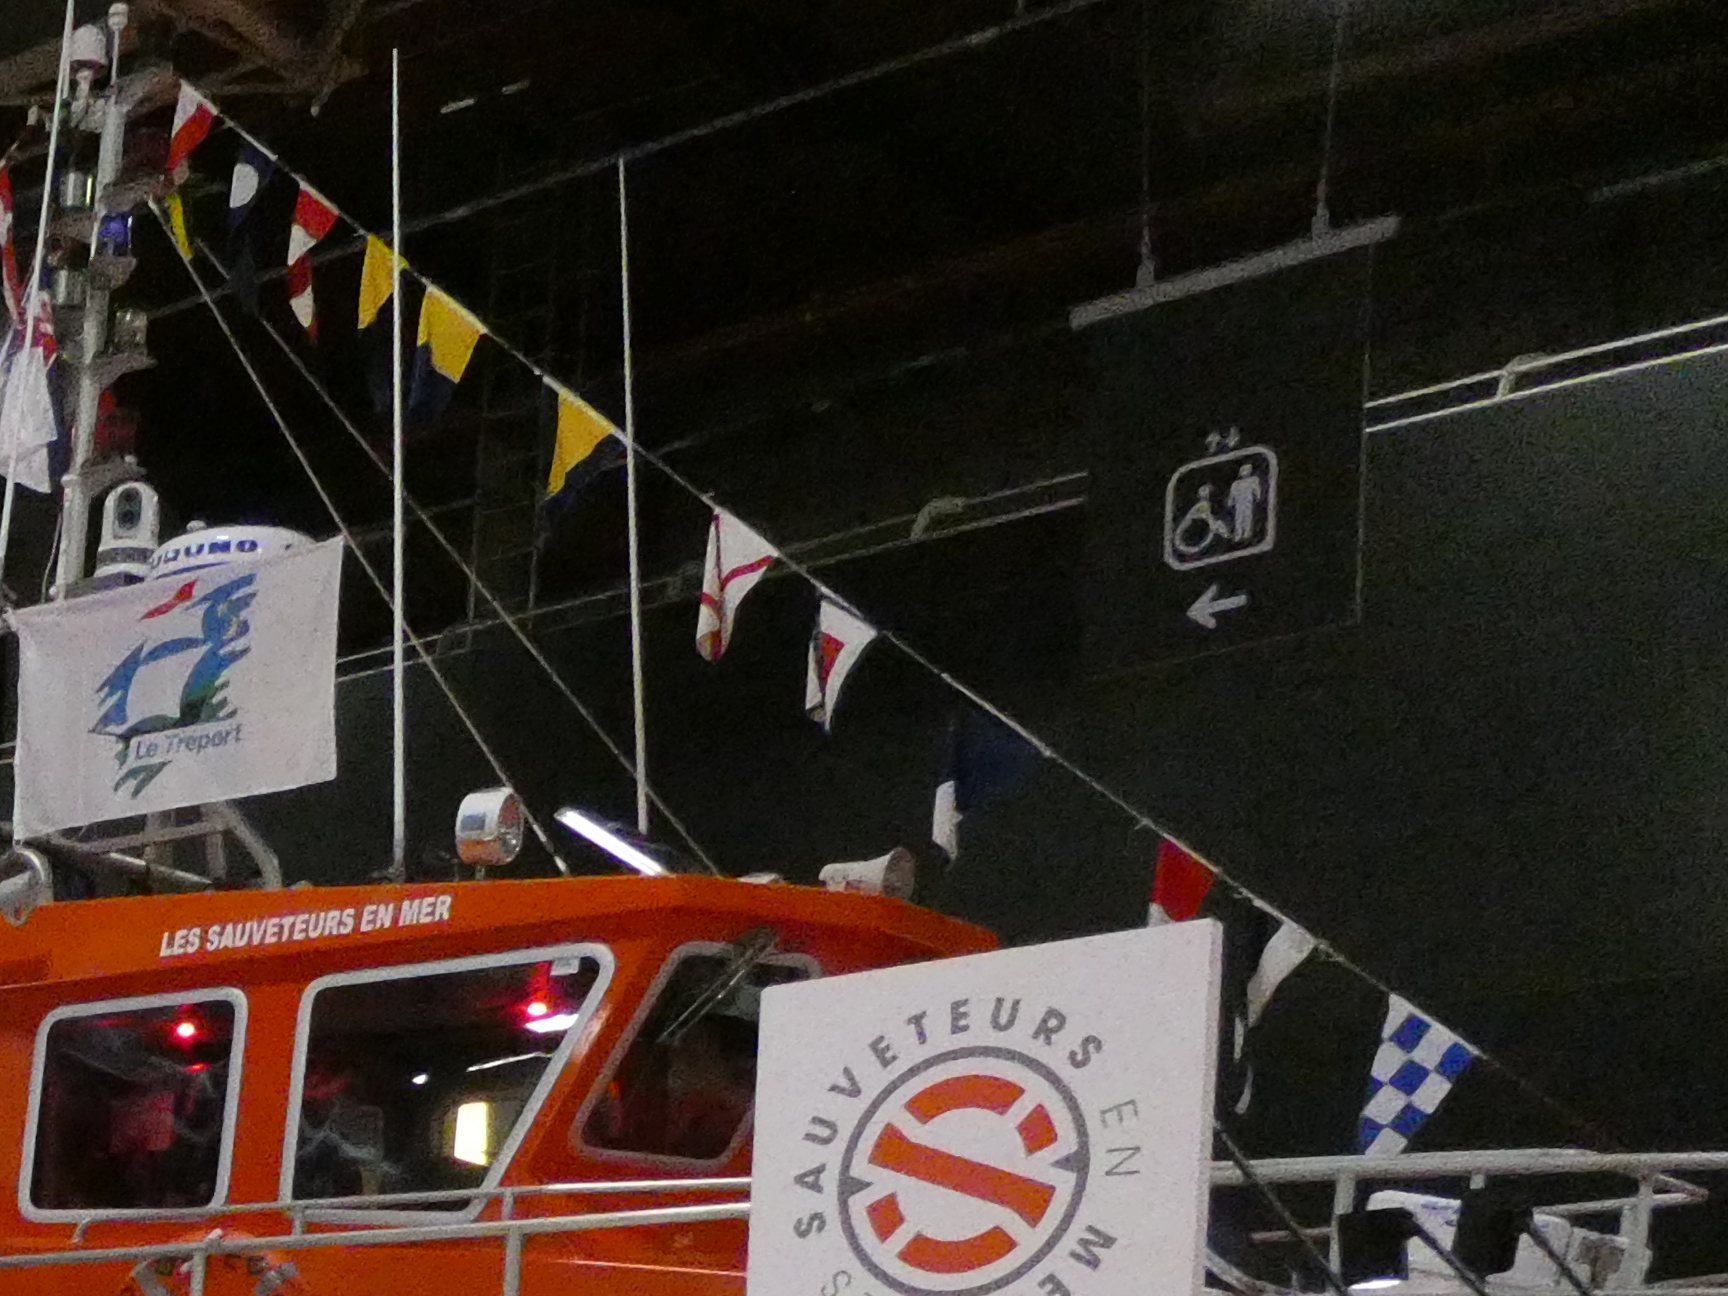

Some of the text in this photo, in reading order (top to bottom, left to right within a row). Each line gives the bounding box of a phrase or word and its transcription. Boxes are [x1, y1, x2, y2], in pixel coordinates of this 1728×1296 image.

[135, 740, 159, 760] Le
[159, 894, 452, 957] LES SAUVETEURS EN MER
[793, 996, 1103, 1240] SAUVETEURS
[1099, 1098, 1142, 1177] EN
